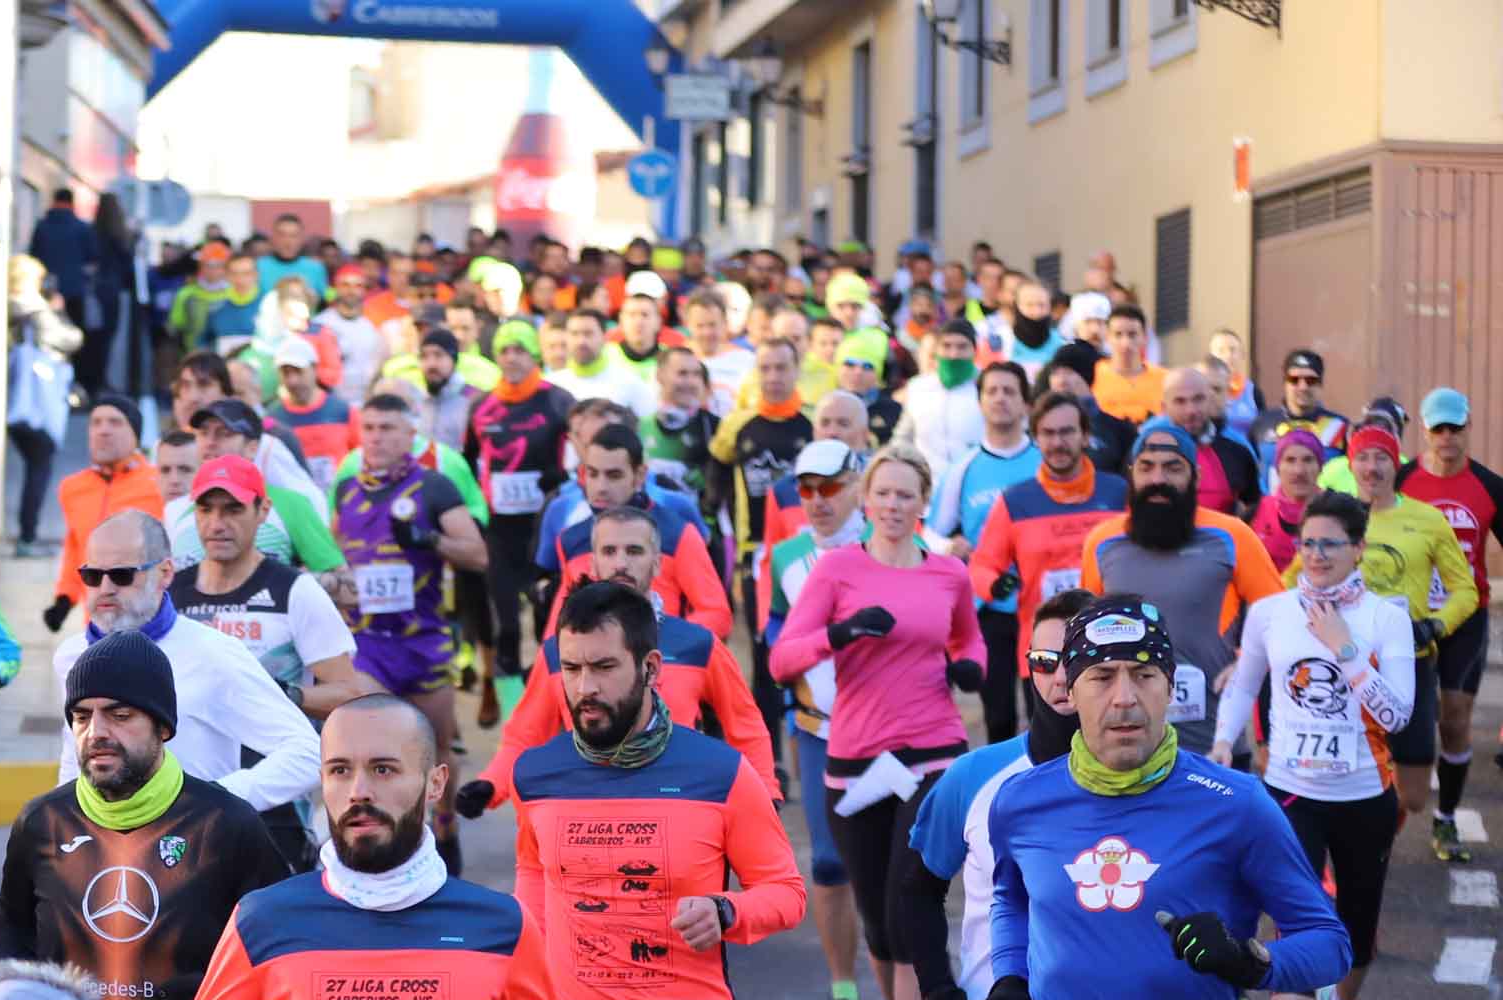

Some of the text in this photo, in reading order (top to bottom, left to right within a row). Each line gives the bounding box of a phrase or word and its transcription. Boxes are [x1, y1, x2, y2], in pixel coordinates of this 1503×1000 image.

[1296, 733, 1340, 757] 774
[567, 823, 657, 834] 27 LIGA CROSS
[568, 836, 624, 845] CABRERIZOS
[326, 979, 439, 993] 27 LIGA CROSS
